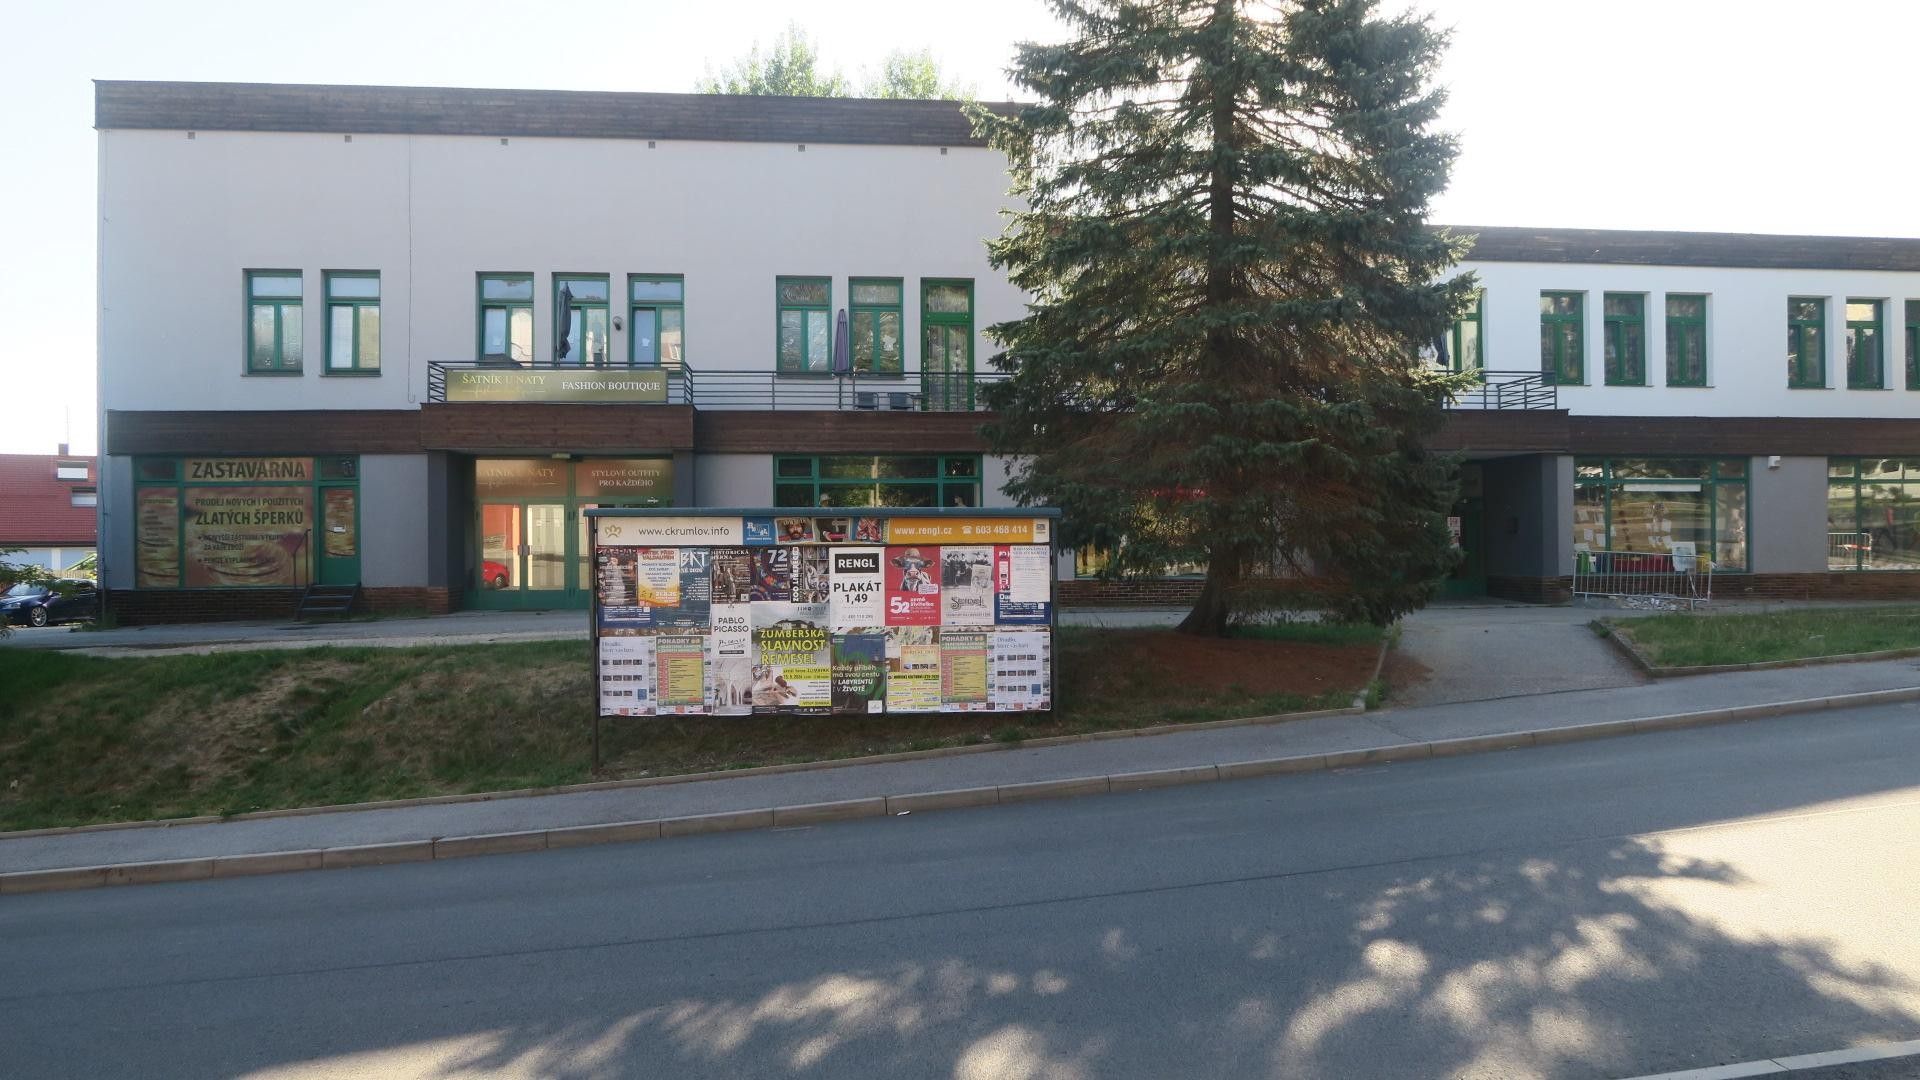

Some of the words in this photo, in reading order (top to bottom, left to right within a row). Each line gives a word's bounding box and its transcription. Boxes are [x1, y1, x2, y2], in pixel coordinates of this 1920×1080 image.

[562, 381, 605, 390] FASHION
[608, 381, 661, 391] BOUTIQUE
[195, 498, 224, 506] PRODEJ
[226, 496, 256, 506] NOVÝCH
[195, 509, 250, 525] ZLATÝCH
[638, 526, 730, 536] www.ckrumlov.info
[894, 525, 952, 536] www.rengl.cz
[975, 525, 991, 534] 603
[1012, 524, 1028, 534] 414
[767, 549, 788, 563] 72
[838, 558, 875, 568] RENGL
[833, 580, 881, 592] PLAKÁT
[845, 593, 868, 605] 1,49
[714, 625, 749, 633] PICASSO
[761, 639, 826, 651] SLAVNOST
[761, 651, 817, 665] ŘEMESEL
[832, 664, 853, 672] Každý
[842, 684, 865, 692] ŽIVOTĚ
